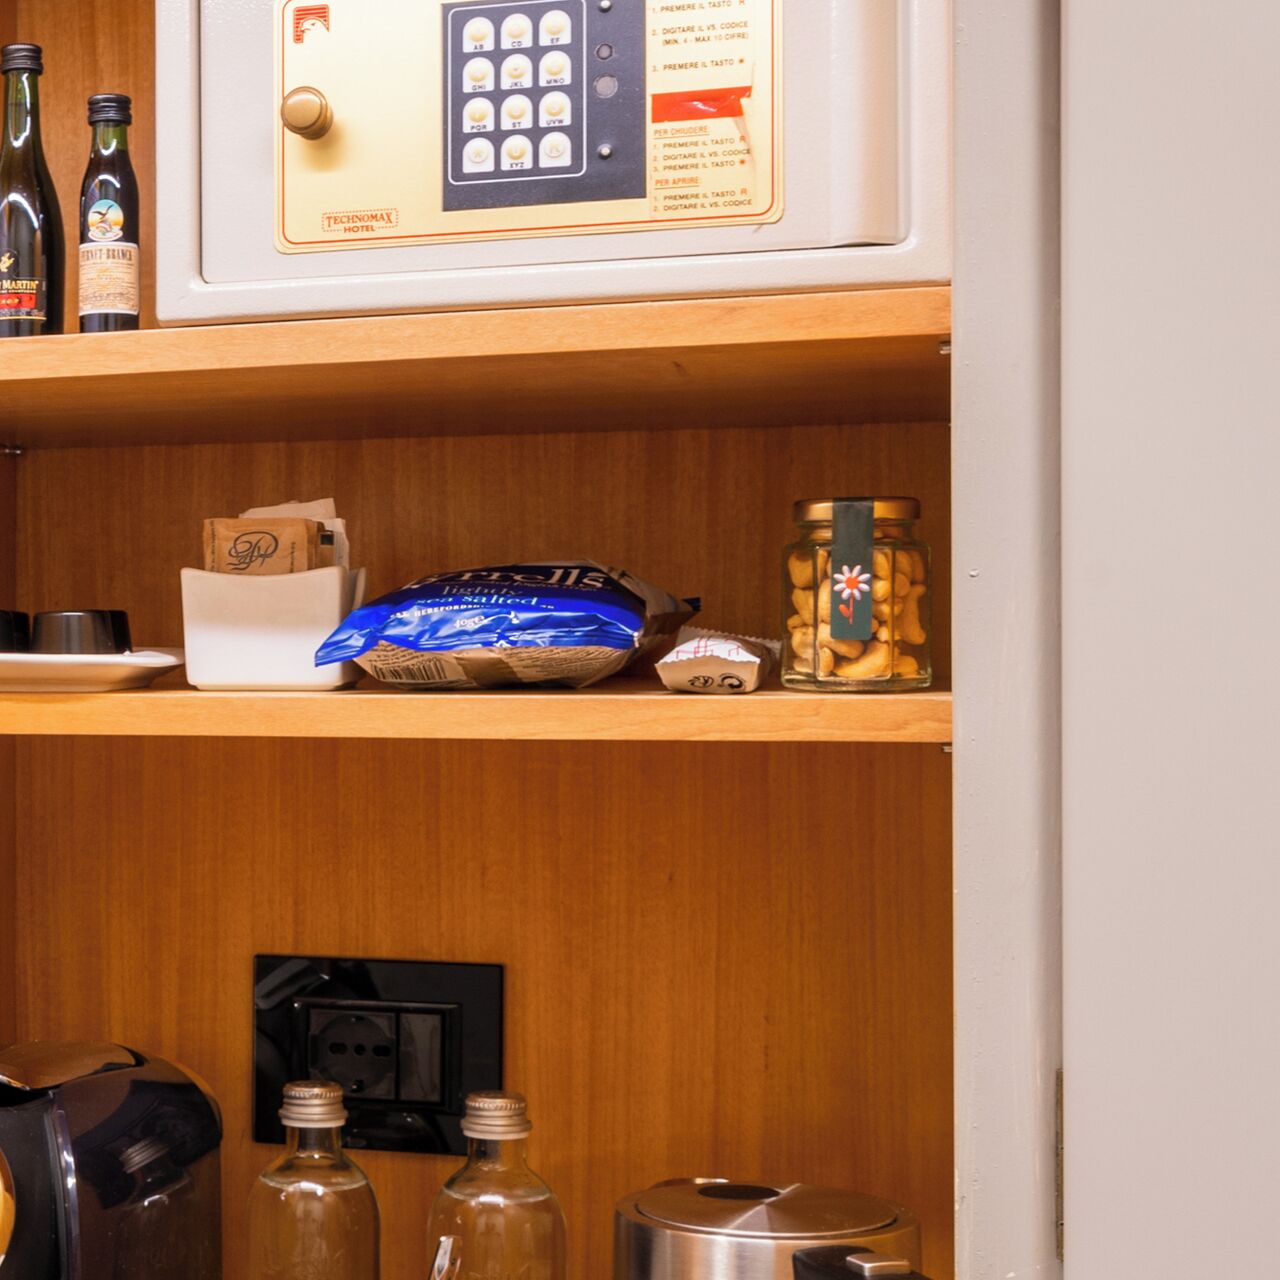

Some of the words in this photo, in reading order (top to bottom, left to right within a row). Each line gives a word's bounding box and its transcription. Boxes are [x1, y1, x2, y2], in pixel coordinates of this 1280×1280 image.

[660, 3, 696, 12] PREMERE
[708, 0, 732, 8] TASTO
[662, 25, 695, 35] DIGITARE
[720, 21, 748, 30] CODICE
[663, 61, 698, 71] PREMERE
[710, 58, 735, 66] TASTO
[663, 153, 697, 161] DIGITARE
[722, 148, 751, 156] CODICE
[663, 163, 699, 171] PREMERE
[663, 193, 700, 201] PREMERE
[711, 190, 736, 198] TASTO
[663, 203, 698, 211] DIGITARE
[722, 199, 752, 207] CODICE
[325, 212, 393, 228] TECHNOMAX
[343, 225, 376, 233] HOTEL
[3, 279, 37, 290] MARTIN
[462, 594, 538, 606] salted
